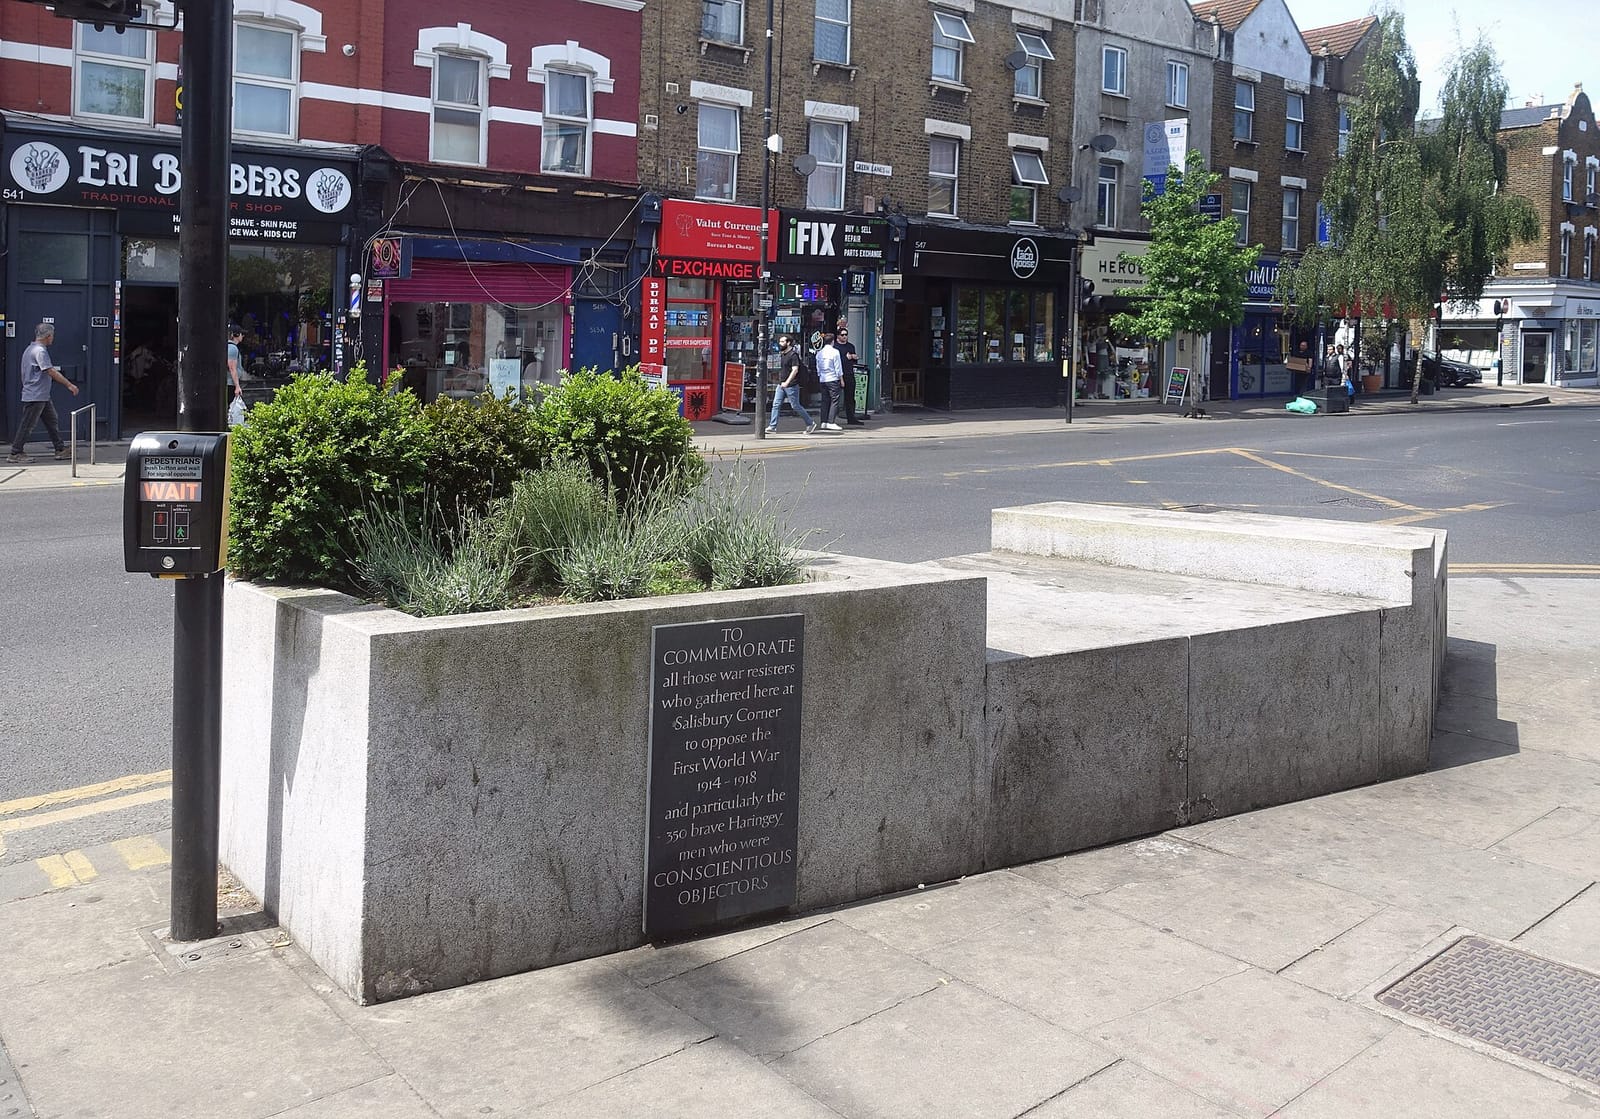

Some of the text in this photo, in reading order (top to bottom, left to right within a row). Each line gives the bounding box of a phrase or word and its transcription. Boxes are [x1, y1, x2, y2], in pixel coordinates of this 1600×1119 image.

[77, 146, 301, 198] ERI BBERS
[3, 189, 24, 200] 541
[82, 191, 175, 206] TRADITIONAL
[245, 203, 283, 212] SHOP
[230, 218, 254, 226] SHAVE
[260, 220, 278, 228] SKIN
[278, 220, 298, 229] FADE
[242, 229, 258, 237] WAX
[264, 230, 281, 238] KIDS
[282, 231, 296, 239] CUT
[696, 218, 721, 229] Valut
[844, 224, 854, 233] BUY
[861, 226, 872, 234] SELL
[788, 218, 837, 256] iFIX
[844, 234, 861, 242] REPAIR
[844, 249, 858, 257] PARTS
[658, 260, 668, 272] Y
[672, 260, 753, 278] EXCHANGE
[650, 282, 659, 330] BUREAU
[649, 338, 658, 353] DE
[144, 482, 198, 500] WAIT
[721, 628, 742, 642] TO
[663, 639, 796, 666] COMMEMORATE
[662, 662, 795, 688] all those war resisters
[662, 684, 794, 710] who gathered here at
[674, 707, 782, 730] Salisbury Corner
[686, 728, 771, 751] to oppose the
[672, 749, 780, 776] First World War
[698, 777, 722, 793] 1914
[734, 770, 756, 786] 1918
[664, 788, 786, 820] and particularly the
[666, 812, 783, 844] 350 brave Haringey
[679, 836, 770, 861] men who were
[654, 850, 792, 888] CONSCIENTIOUS
[678, 875, 768, 904] OBJECTORS
